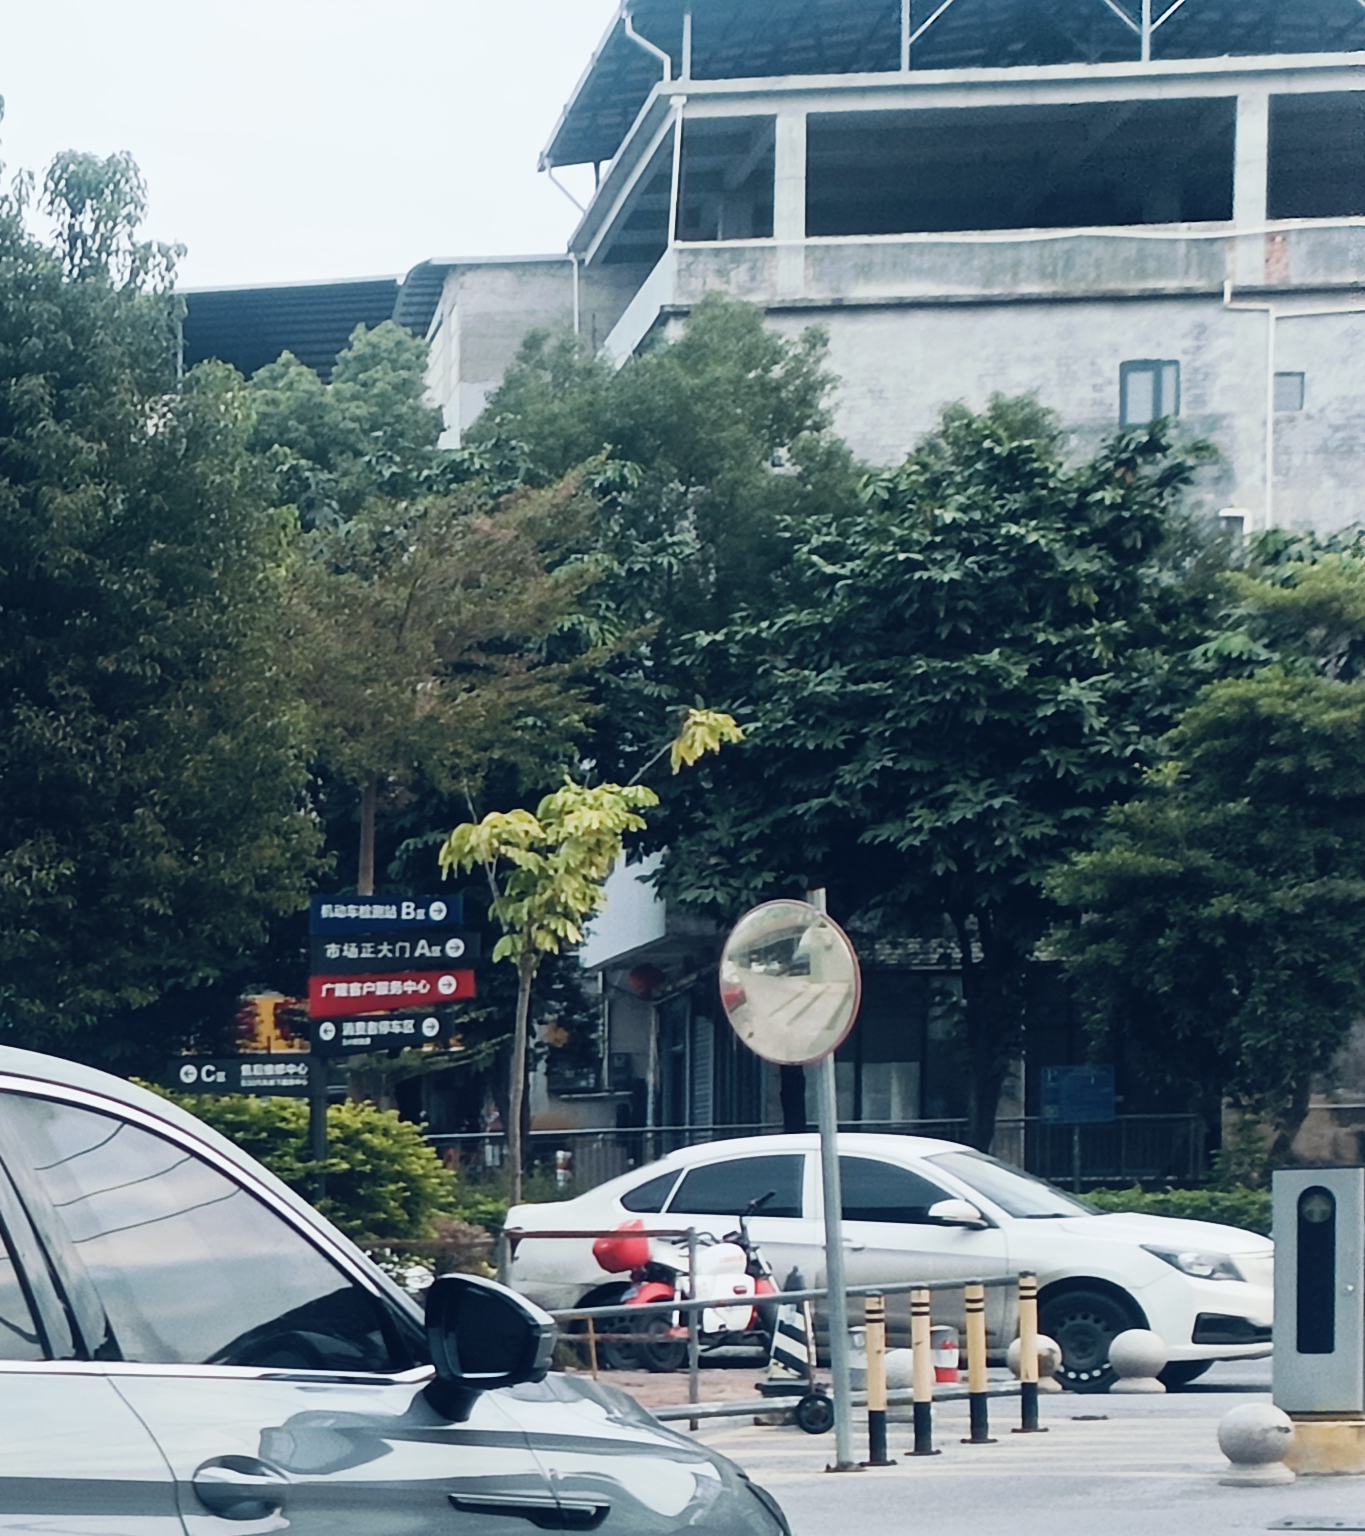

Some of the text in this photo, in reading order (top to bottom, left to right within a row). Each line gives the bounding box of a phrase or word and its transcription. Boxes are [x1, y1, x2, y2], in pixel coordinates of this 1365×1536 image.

[325, 940, 410, 959] 市场正大门
